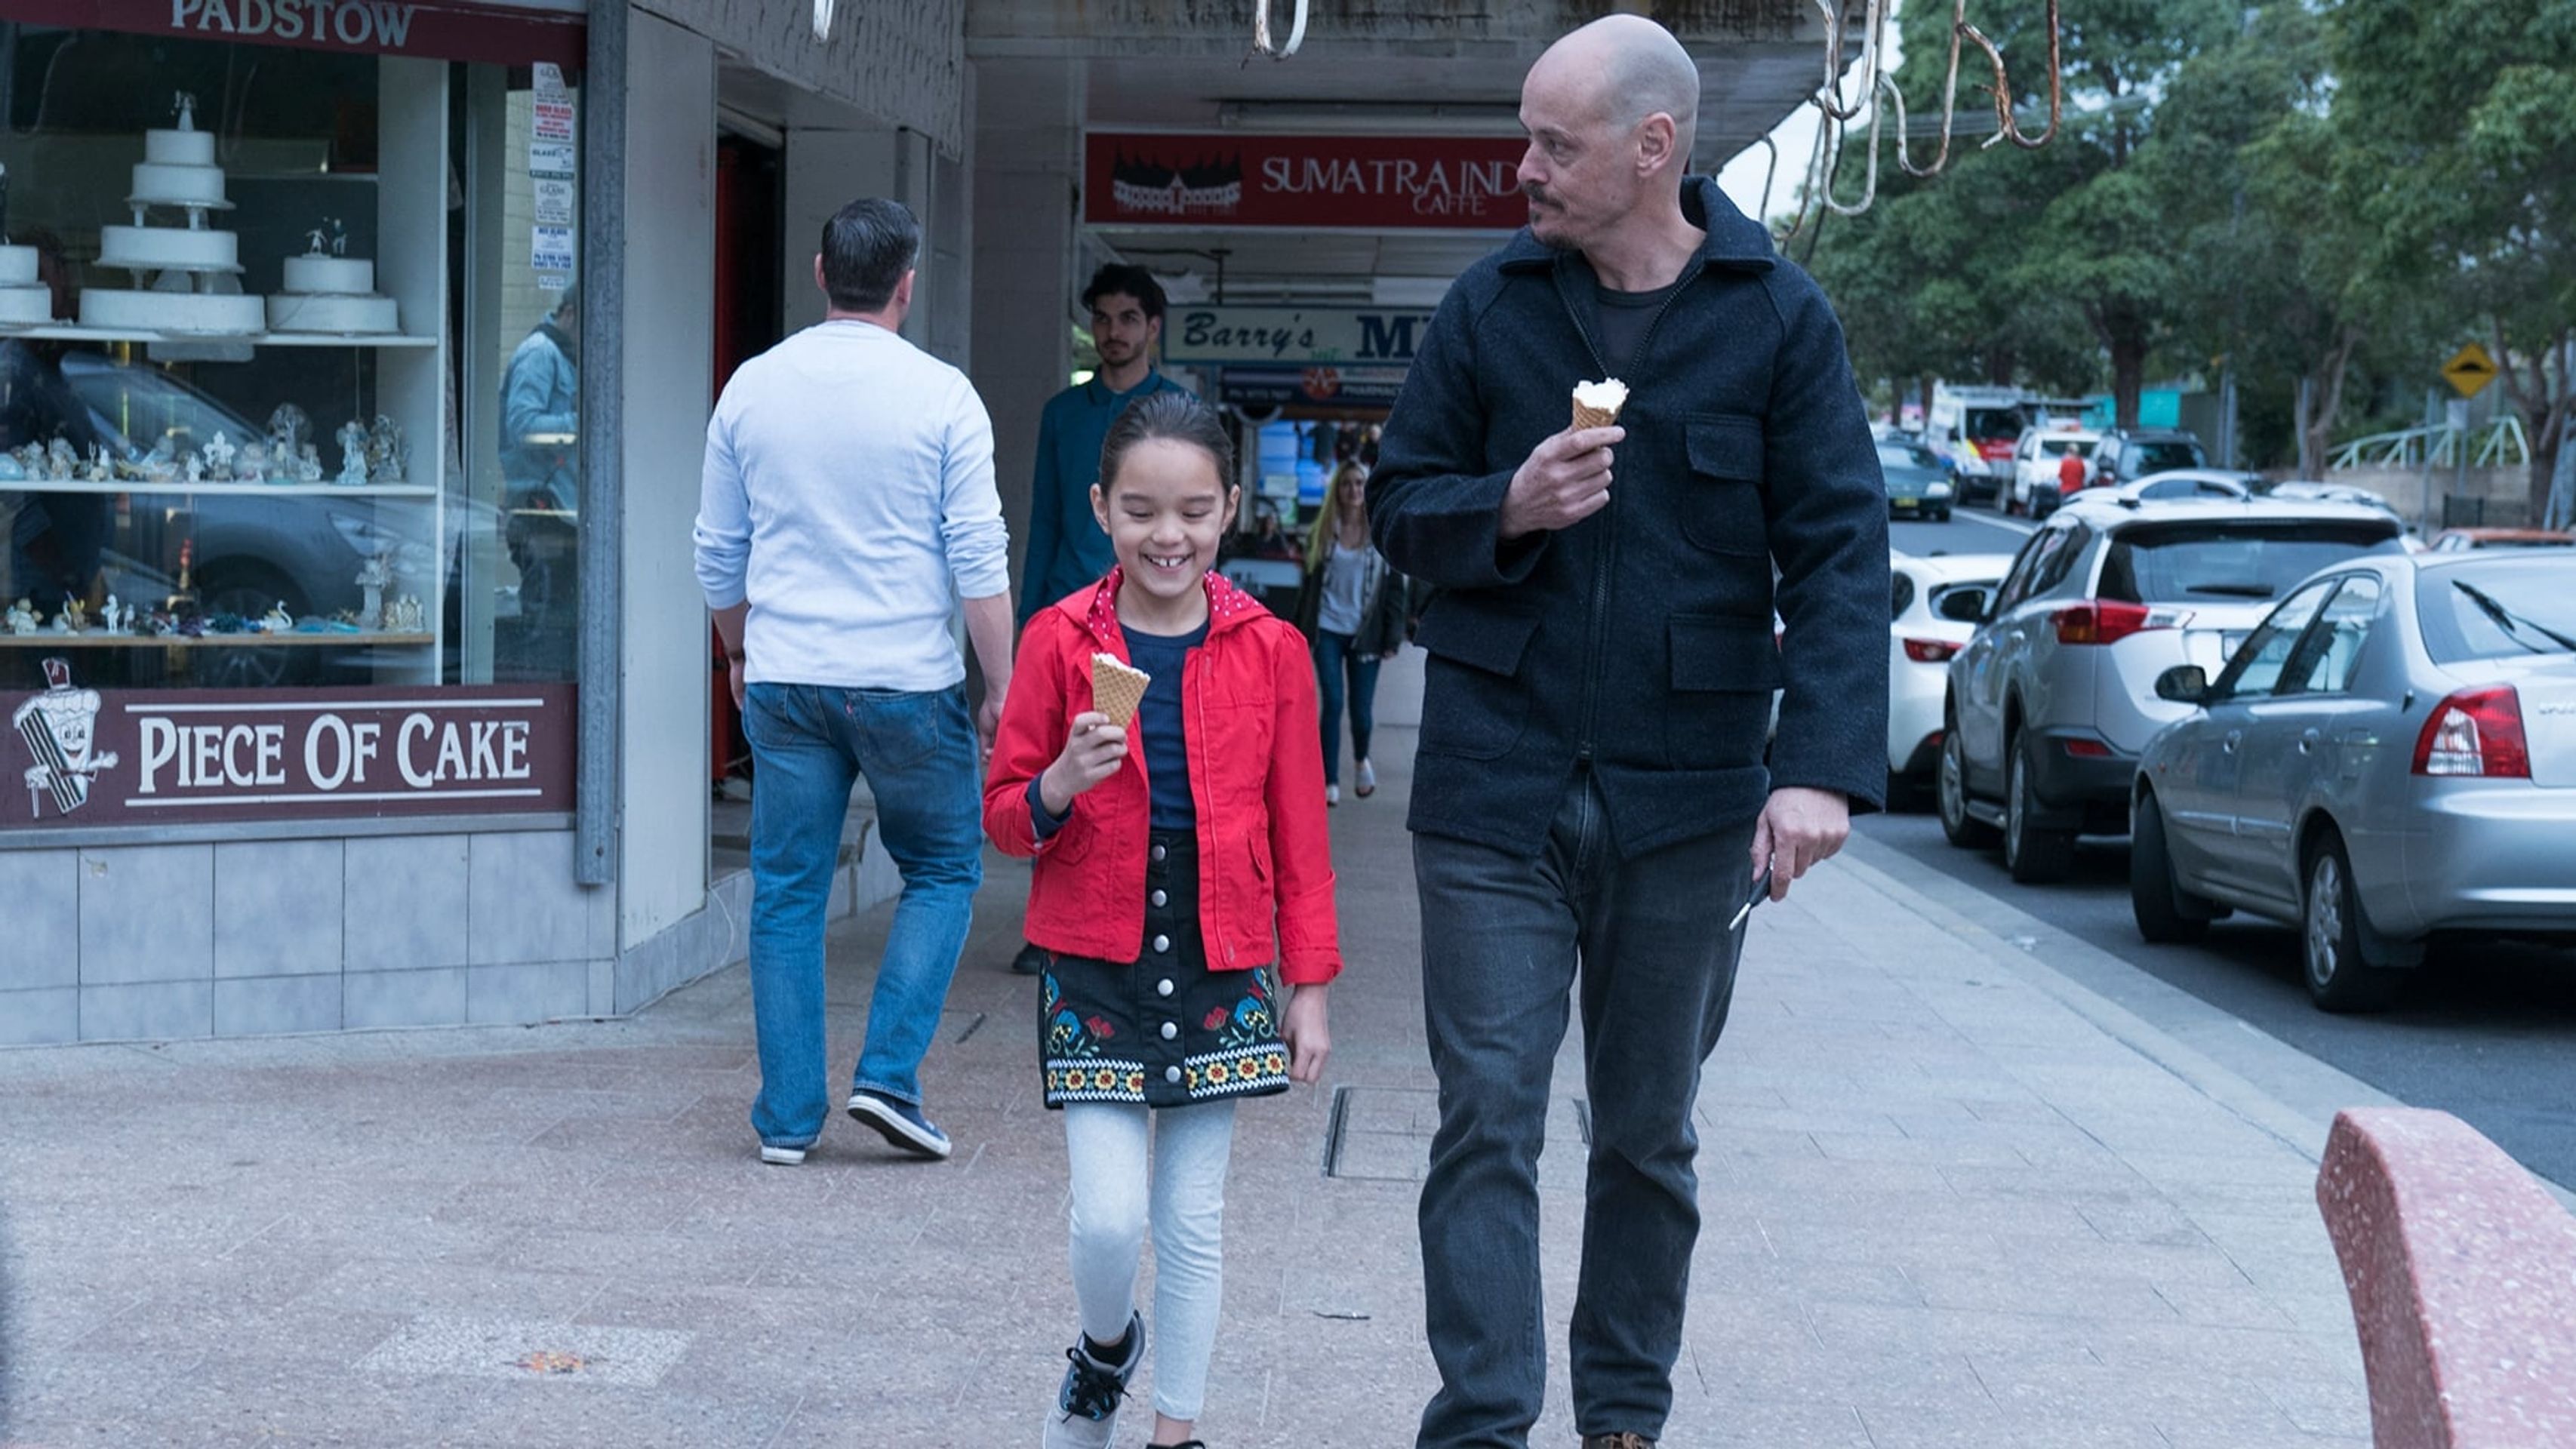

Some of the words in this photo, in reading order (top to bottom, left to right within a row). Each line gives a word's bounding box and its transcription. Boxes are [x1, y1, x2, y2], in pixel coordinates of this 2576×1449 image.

[171, 0, 414, 47] PADSTOW
[1261, 156, 1451, 195] SUMATRA
[1183, 310, 1317, 358] Barry's
[1355, 314, 1432, 358] M
[140, 716, 285, 793] PIECE
[304, 712, 380, 790] OF
[397, 712, 530, 788] CAKE
